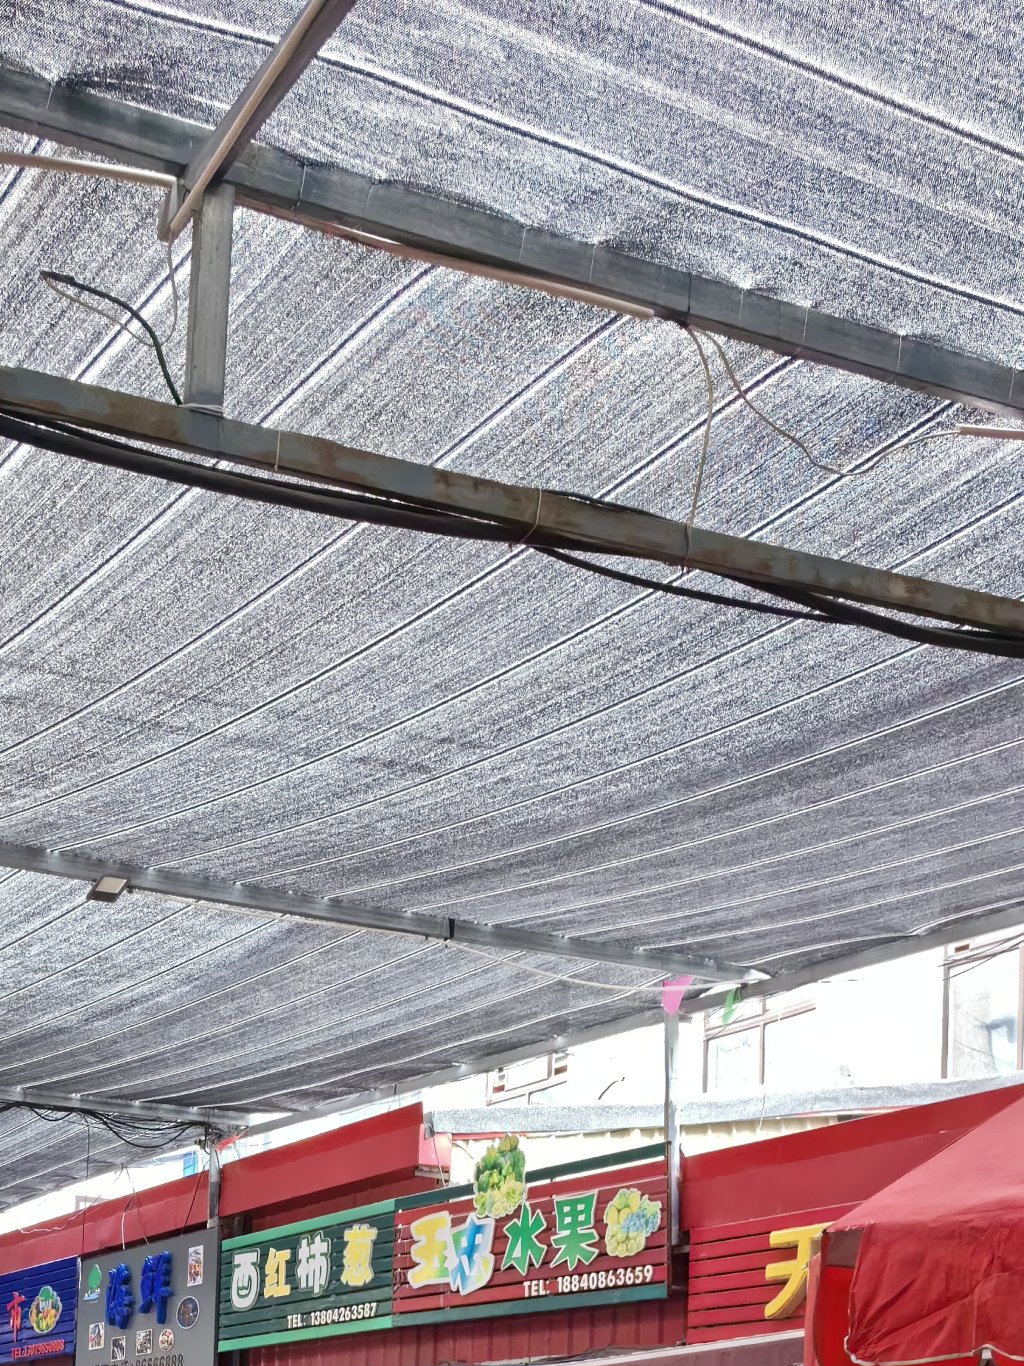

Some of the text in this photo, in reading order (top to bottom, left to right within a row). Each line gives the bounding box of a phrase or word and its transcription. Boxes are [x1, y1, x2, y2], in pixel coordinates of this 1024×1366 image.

[230, 1223, 378, 1312] 西红柿葱
[522, 1265, 654, 1298] TEL: 18840863659
[286, 1302, 378, 1330] TEL: 13804263587
